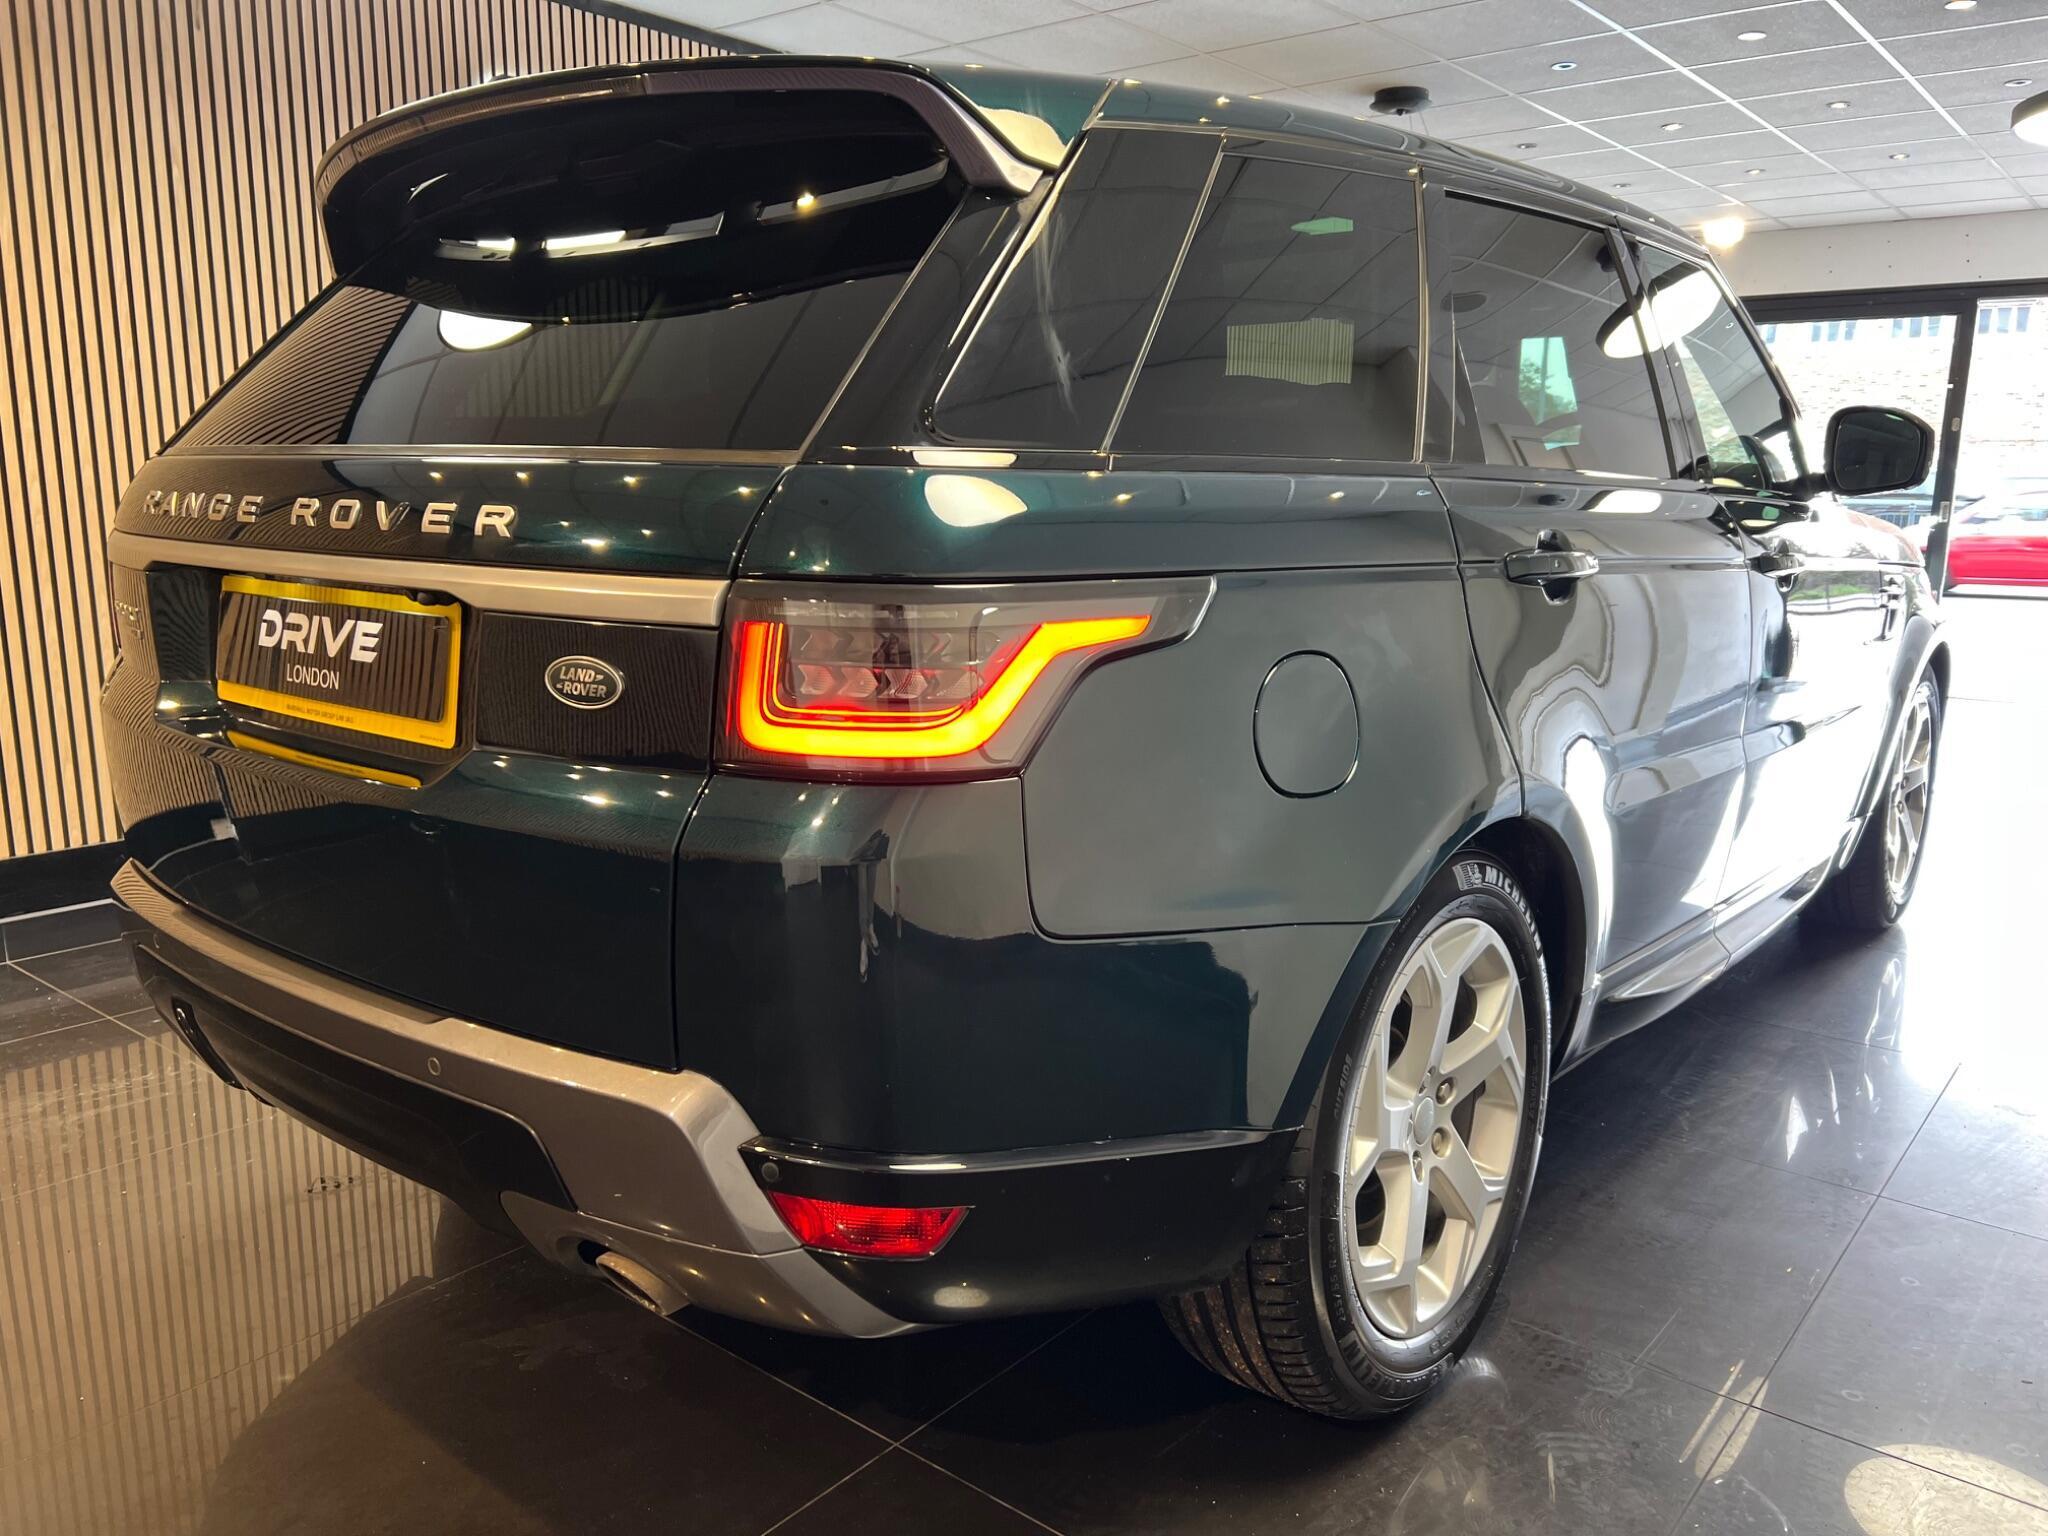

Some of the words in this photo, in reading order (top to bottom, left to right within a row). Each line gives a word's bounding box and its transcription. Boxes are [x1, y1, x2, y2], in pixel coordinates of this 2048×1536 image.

[143, 490, 264, 523] RANGE
[290, 497, 518, 538] ROVER
[258, 609, 384, 663] DRIVE
[286, 663, 340, 690] LONDON
[560, 666, 595, 683] LAND
[563, 681, 607, 698] ROVER
